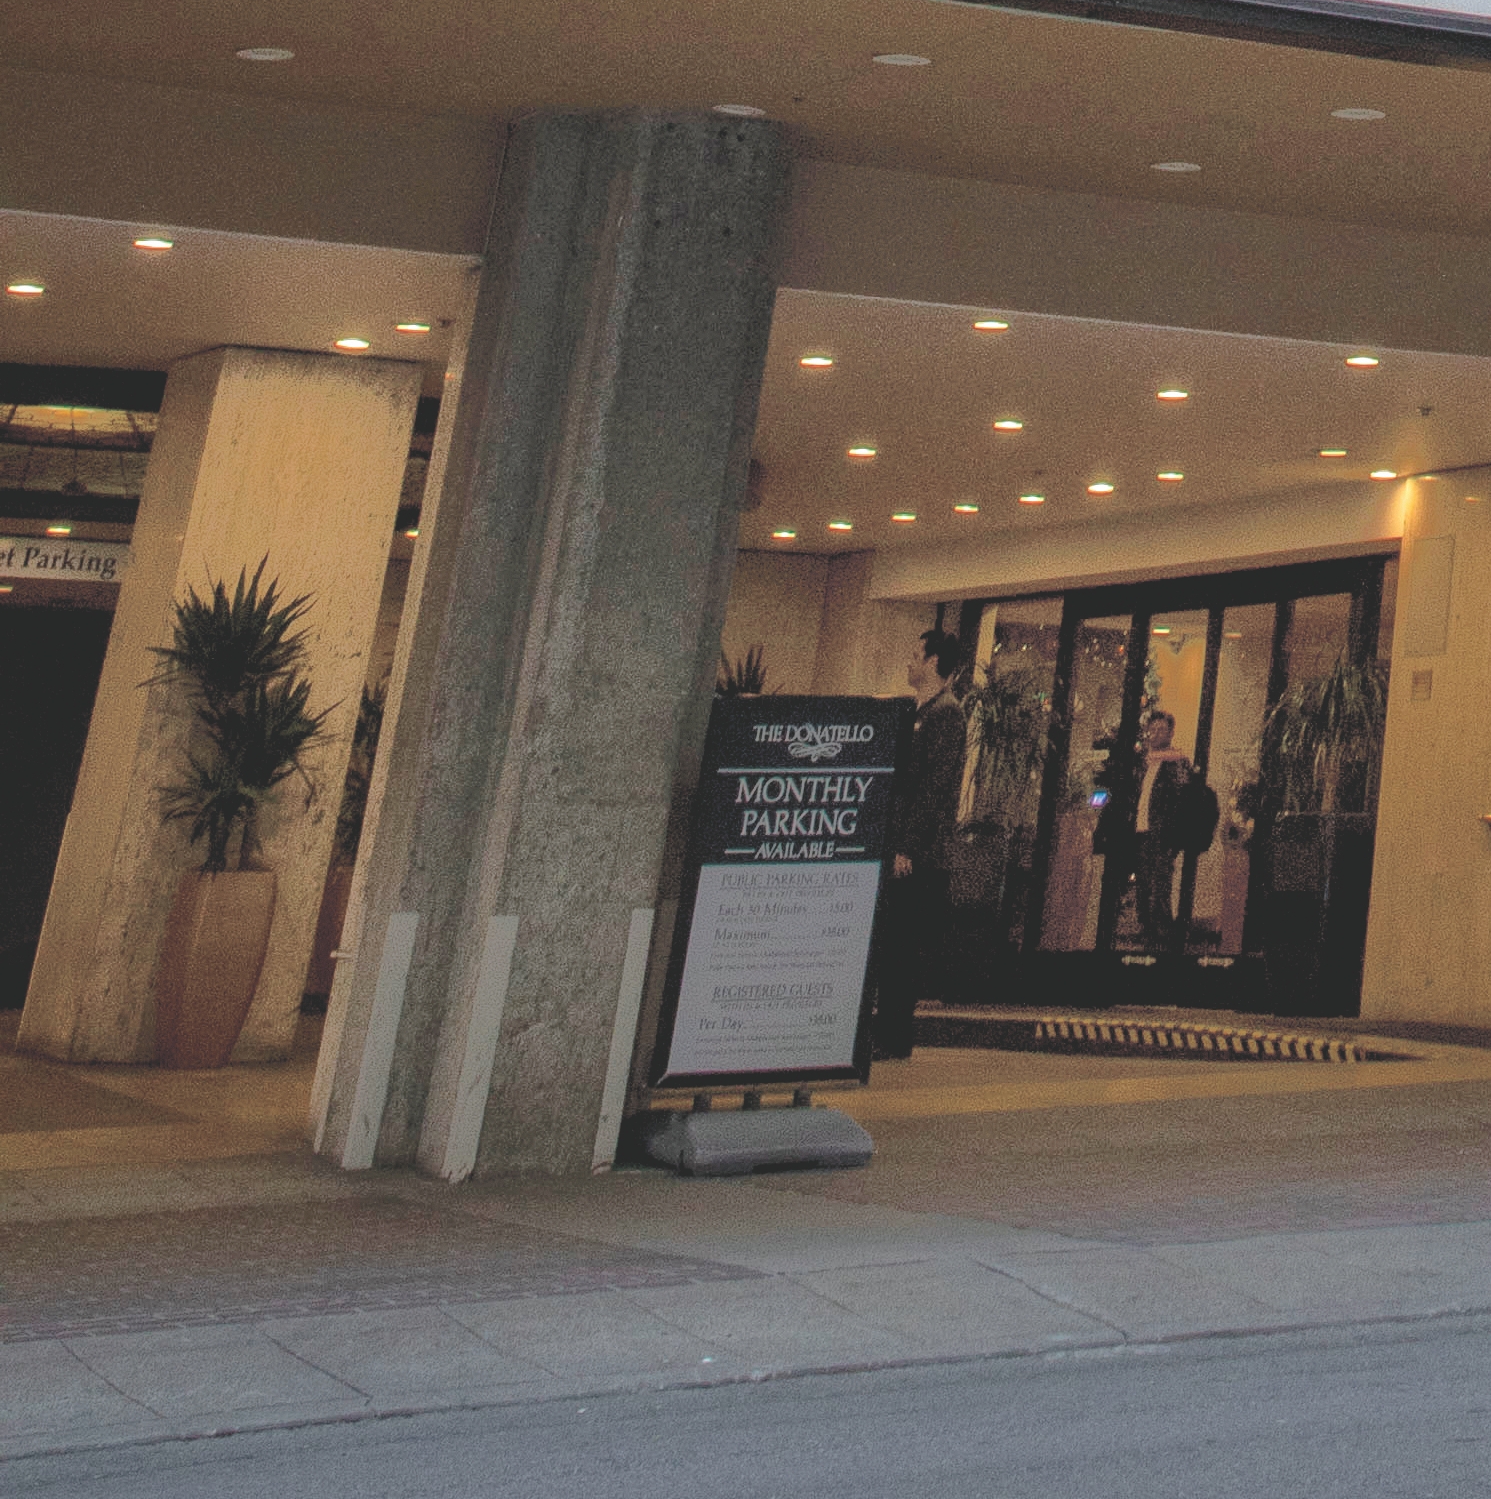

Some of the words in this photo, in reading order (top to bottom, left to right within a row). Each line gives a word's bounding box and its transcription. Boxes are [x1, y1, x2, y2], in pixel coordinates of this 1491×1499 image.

[0, 544, 15, 567] et
[22, 546, 117, 580] Parking
[753, 724, 783, 743] THE
[785, 723, 874, 744] DONATELLO
[735, 775, 874, 803] MONTHLY
[740, 808, 857, 836] PARKING
[754, 842, 834, 860] AVAILABLE
[720, 874, 762, 888] PUBLIC
[766, 872, 819, 887] PARKING
[822, 871, 860, 886] RATES
[714, 928, 771, 941] Maximum
[713, 984, 787, 999] REGISTERED
[789, 981, 834, 996] GUESTS
[699, 1018, 717, 1030] Per
[721, 1017, 744, 1033] Day
